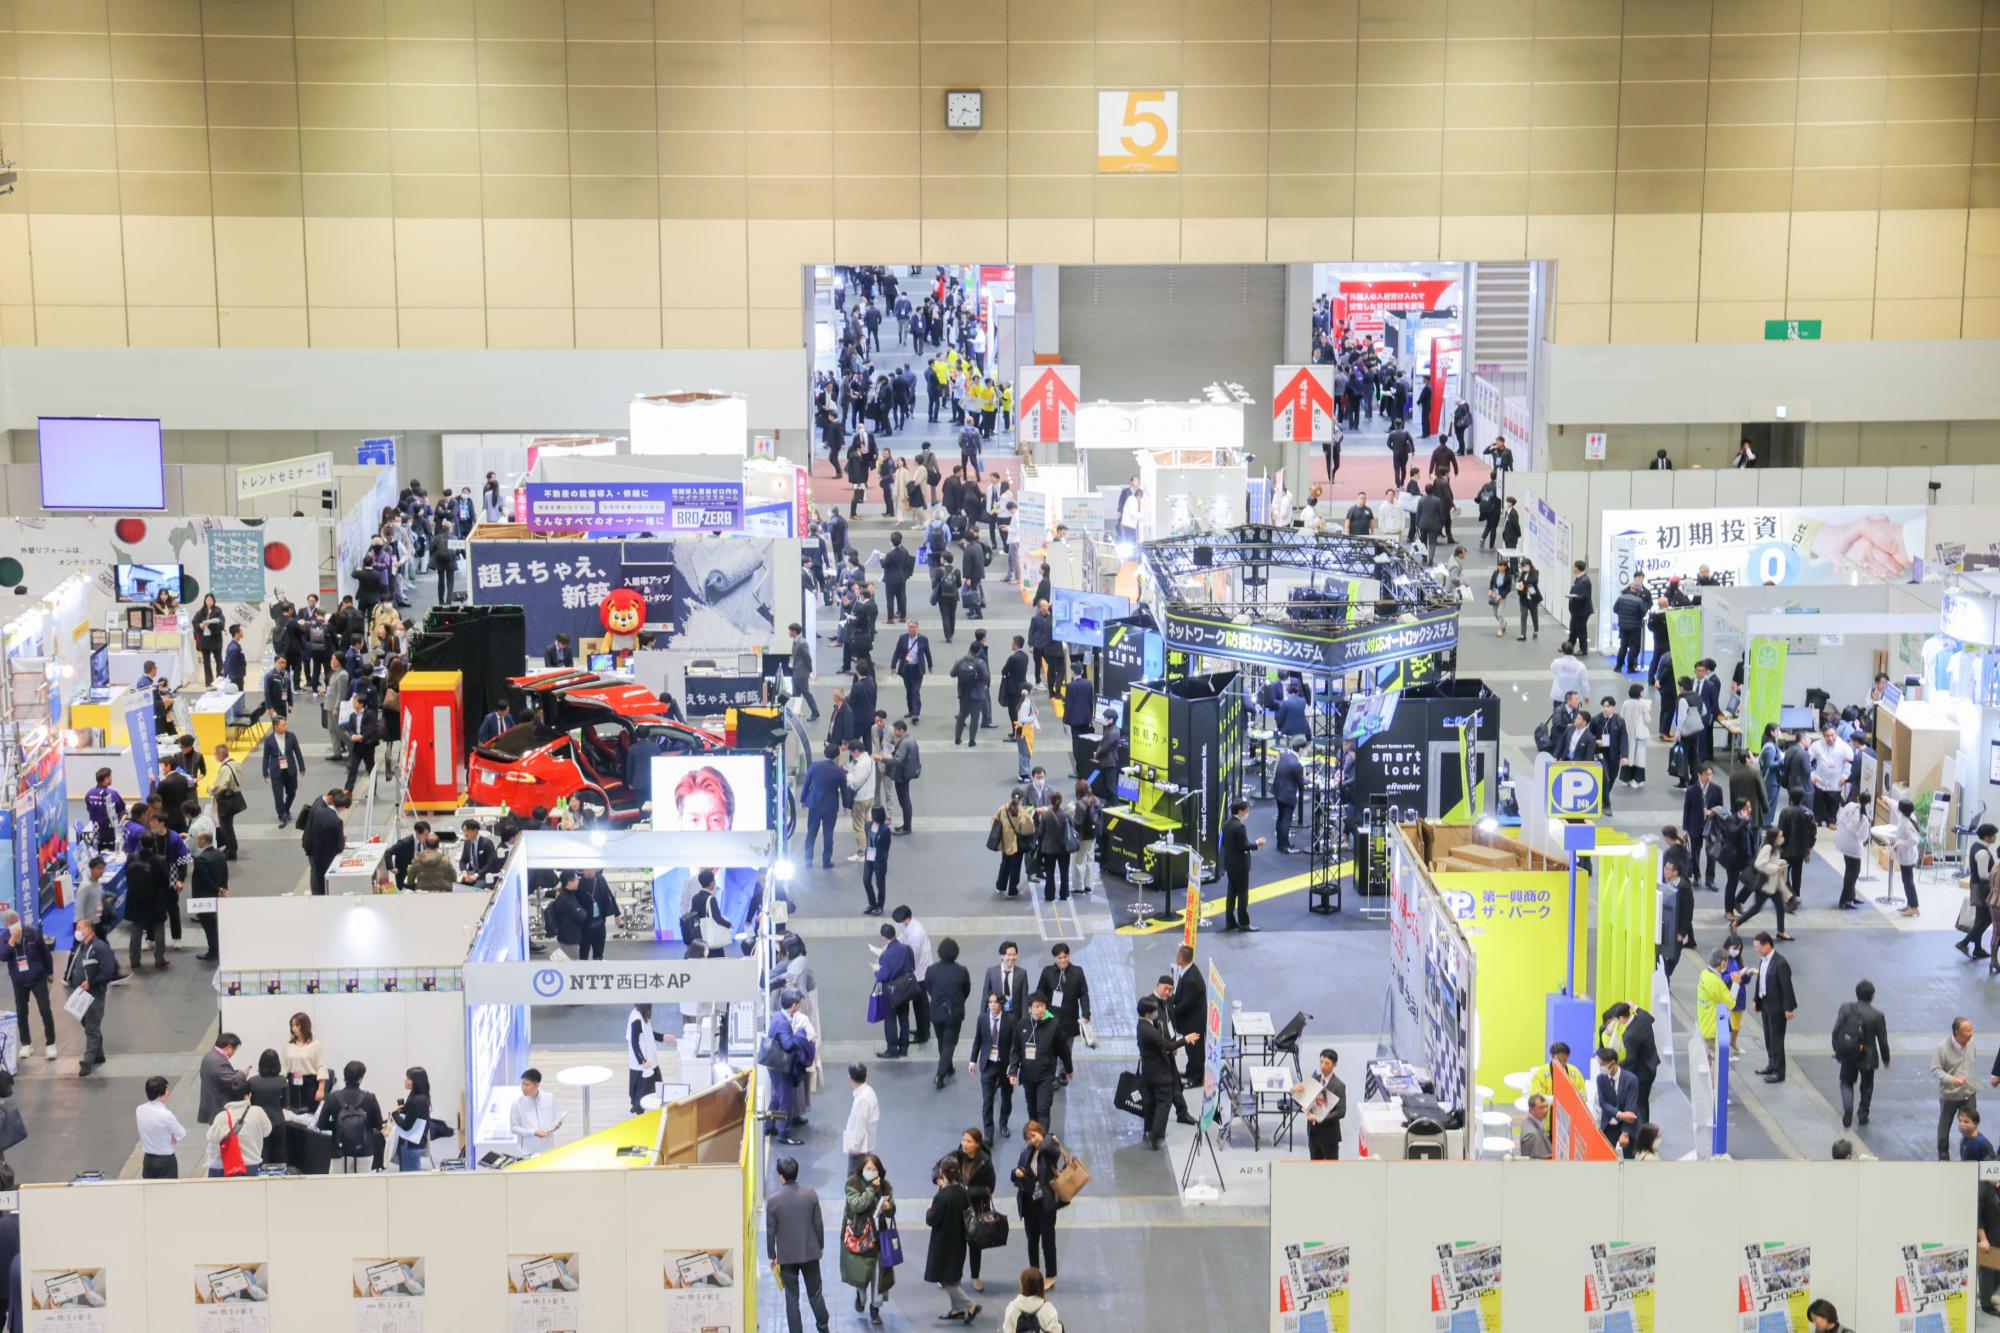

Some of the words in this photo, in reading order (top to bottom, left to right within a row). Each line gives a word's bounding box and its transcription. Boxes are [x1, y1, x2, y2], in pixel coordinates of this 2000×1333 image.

[1119, 89, 1169, 158] 5
[242, 468, 314, 490] トレンドセミナー
[533, 516, 665, 526] そんなすべてのオーナー様に
[1656, 515, 1777, 550] 初期投資
[477, 555, 607, 589] 超えちゃえ、
[1168, 622, 1324, 661] ネットワーク防犯カメラシステム
[1344, 622, 1455, 660] スマホ対応オートロックシステム
[1371, 750, 1421, 762] smart
[1384, 764, 1421, 776] lock
[1561, 771, 1594, 809] P
[1482, 889, 1552, 904] 第一興商の
[1482, 905, 1552, 919] ザ・パーク
